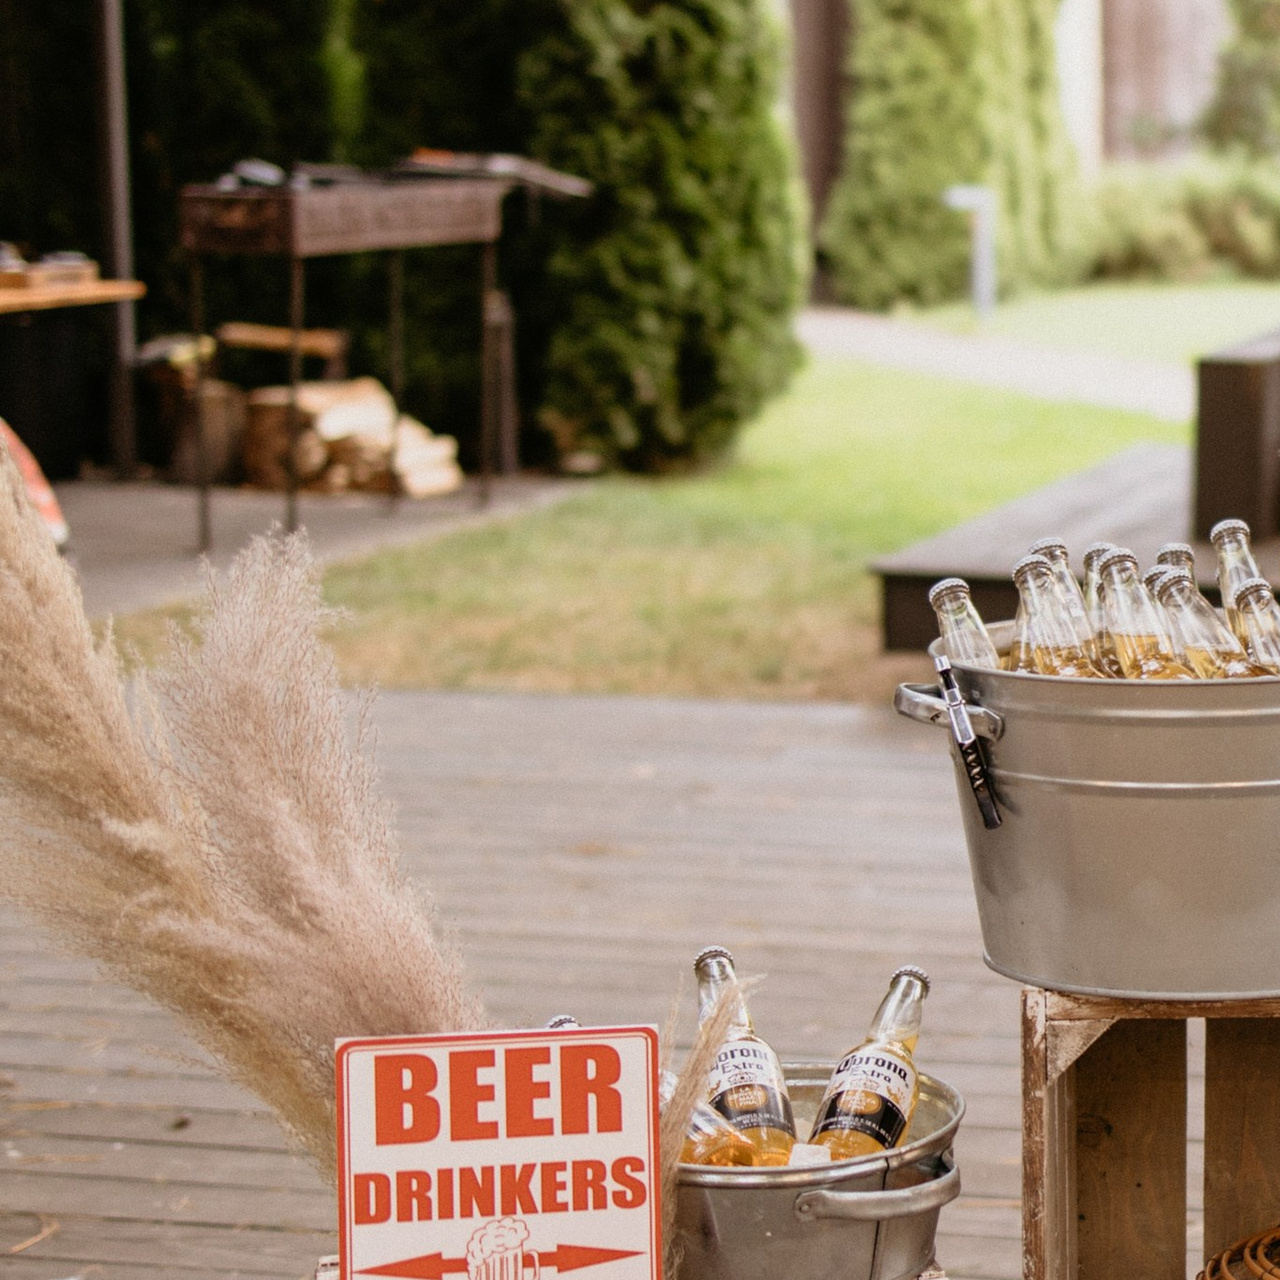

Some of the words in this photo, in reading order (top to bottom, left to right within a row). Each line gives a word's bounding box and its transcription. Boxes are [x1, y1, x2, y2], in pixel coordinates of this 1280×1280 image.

[374, 1044, 623, 1146] BEER
[721, 1062, 764, 1074] Extra
[353, 1156, 647, 1225] DRINKERS
